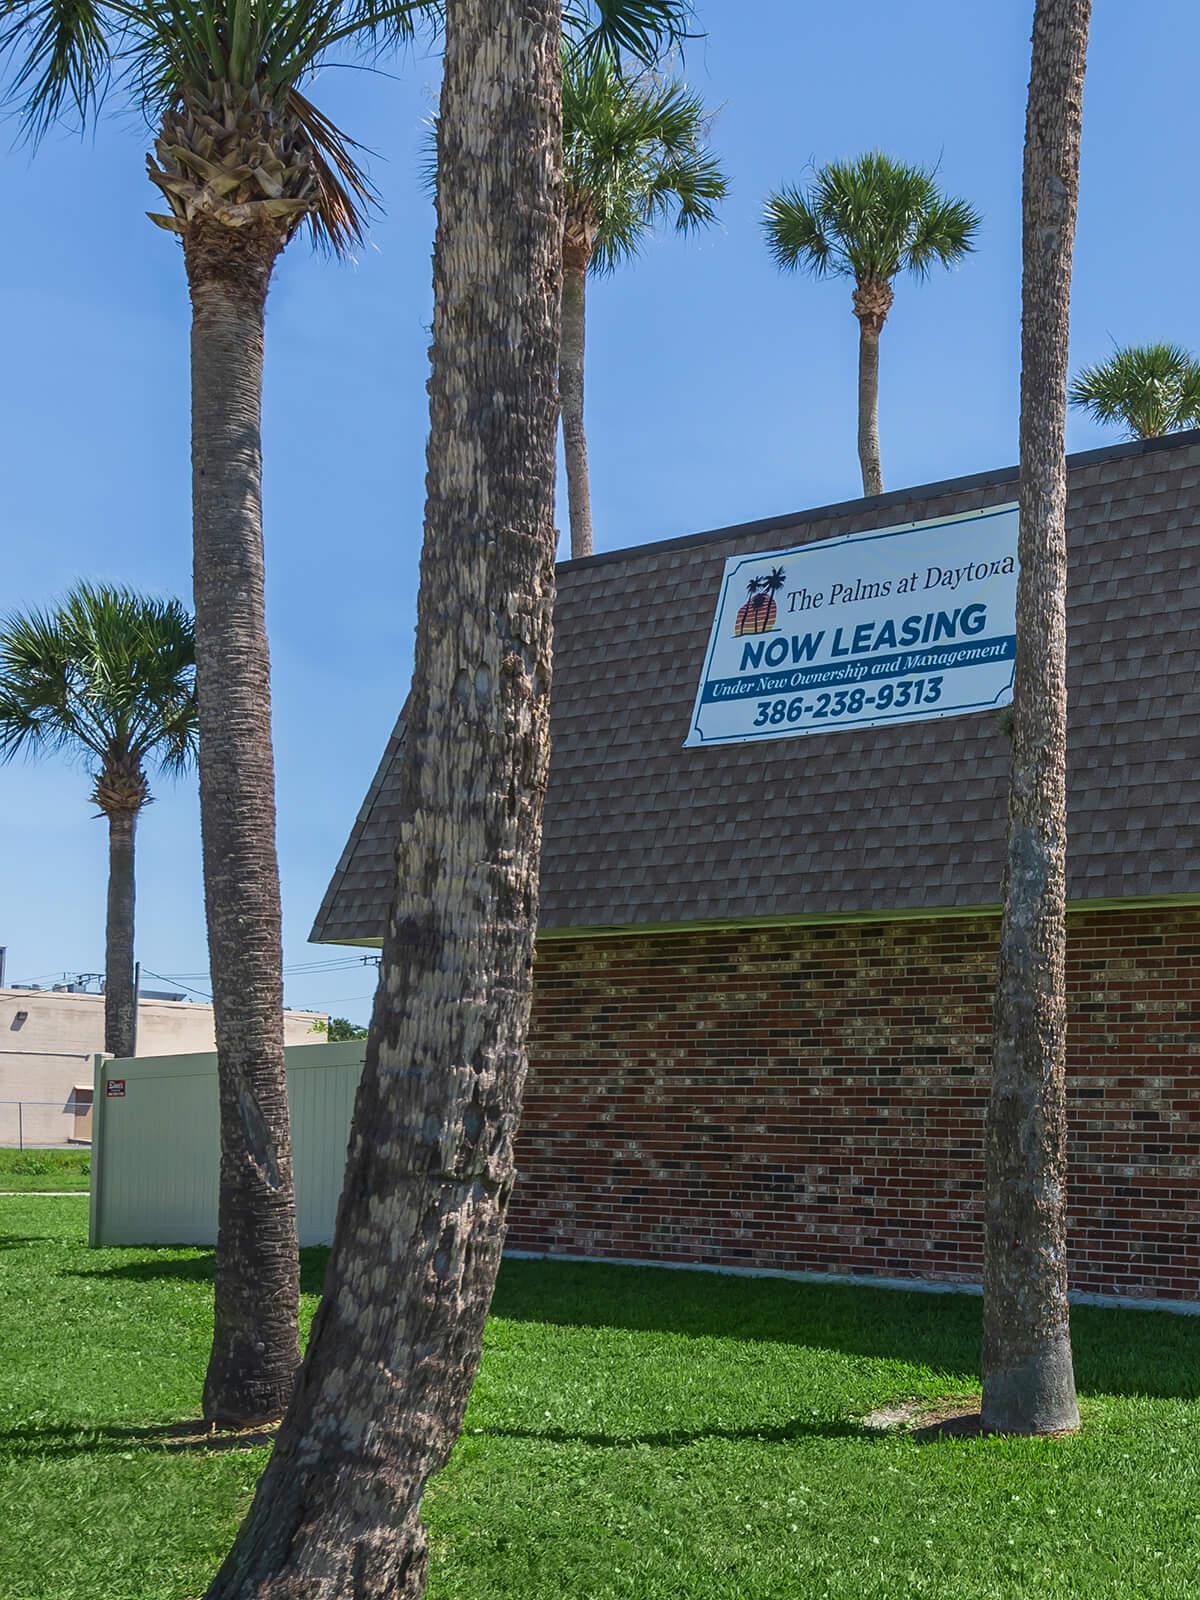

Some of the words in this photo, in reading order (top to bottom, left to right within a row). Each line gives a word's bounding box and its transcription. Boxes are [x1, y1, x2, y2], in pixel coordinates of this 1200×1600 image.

[787, 588, 824, 613] The
[828, 578, 892, 606] Palms
[896, 572, 919, 594] at
[923, 556, 1015, 590] Daytona
[739, 630, 824, 671] NOW
[831, 603, 987, 657] LEASING
[712, 682, 755, 697] Under
[756, 676, 788, 692] New
[790, 663, 869, 687] Ownership
[871, 656, 902, 675] and
[902, 641, 1009, 670] Management
[753, 676, 944, 727] 386-238-9313
